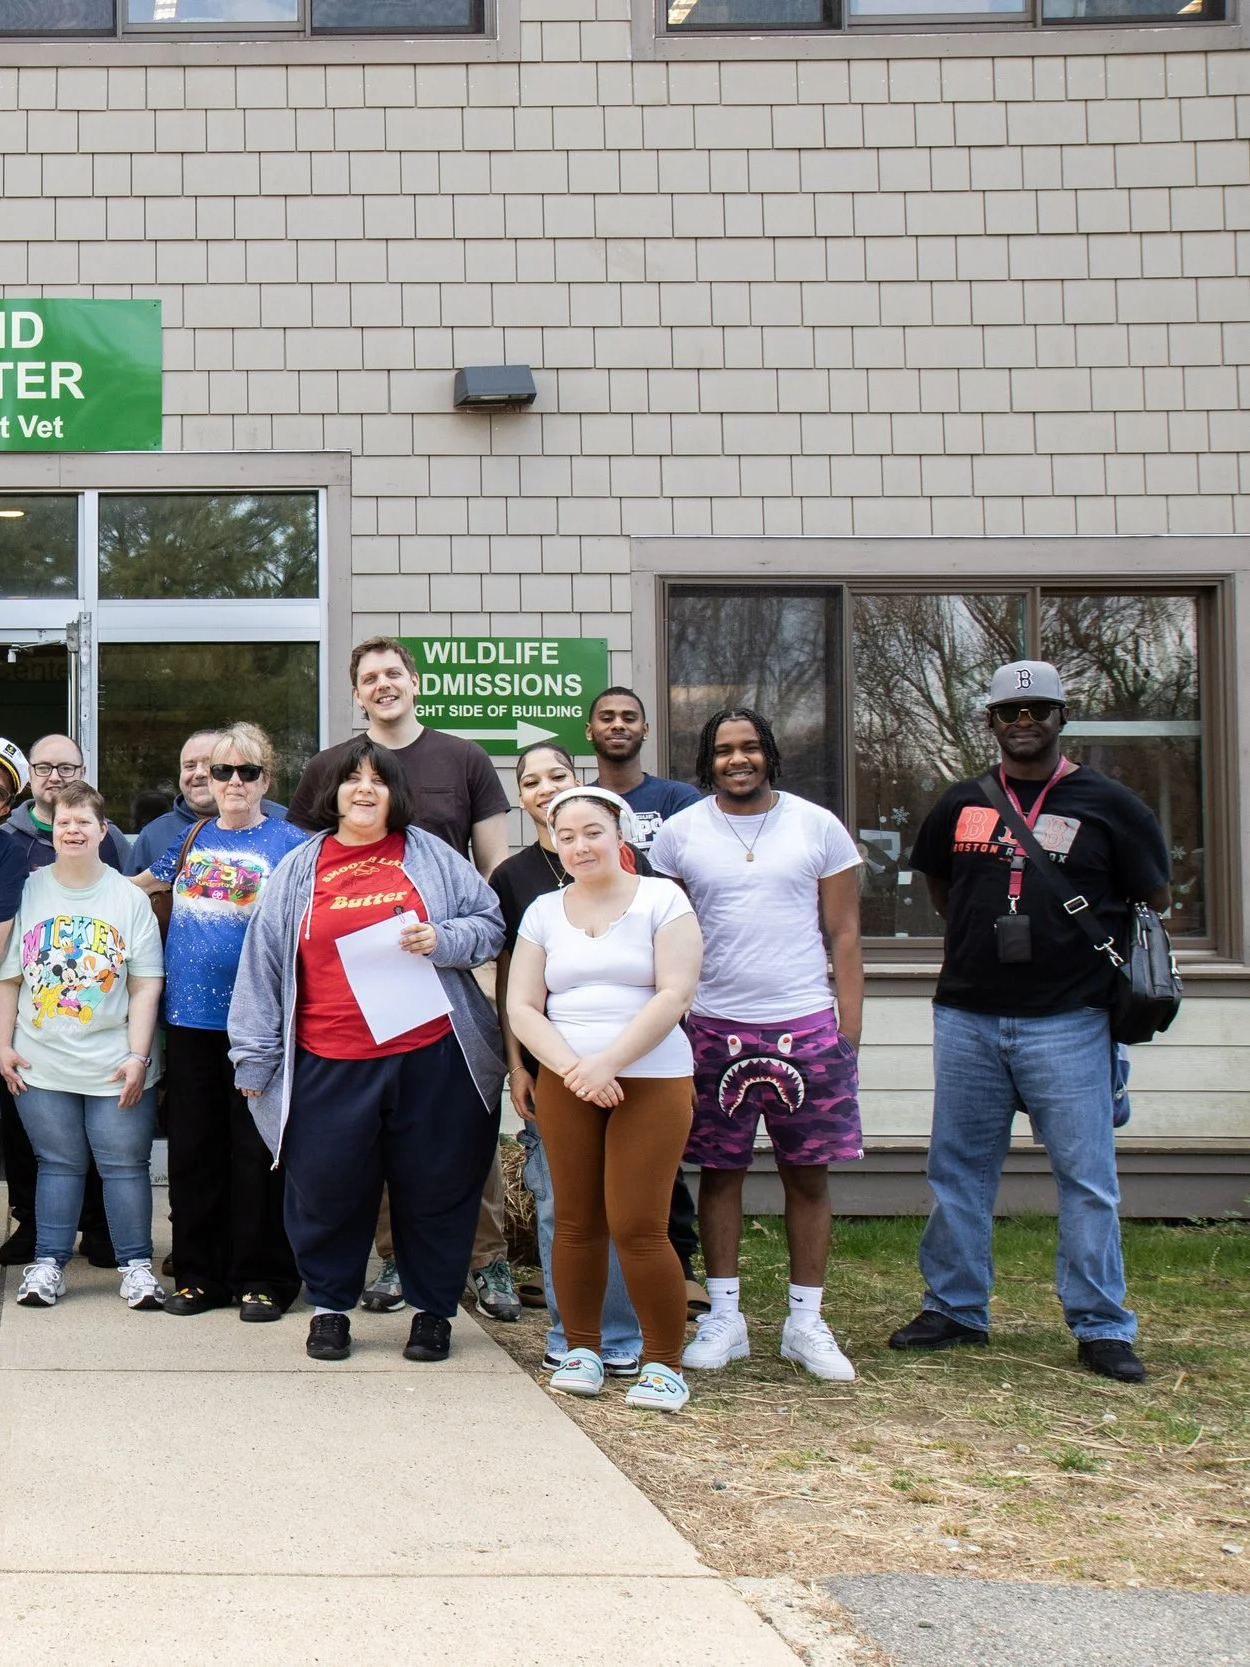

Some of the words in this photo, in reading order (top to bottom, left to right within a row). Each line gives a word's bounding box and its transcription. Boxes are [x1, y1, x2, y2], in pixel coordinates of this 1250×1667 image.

[17, 415, 64, 438] Vet
[423, 642, 559, 664] WILDLIFE
[416, 673, 582, 697] DMISSIONS
[1014, 668, 1034, 690] B
[414, 704, 445, 717] GHT
[449, 704, 483, 717] SIDE
[487, 705, 508, 717] OF
[512, 705, 582, 718] BUILDING
[953, 842, 999, 854] BOSTON
[329, 891, 408, 910] Butter
